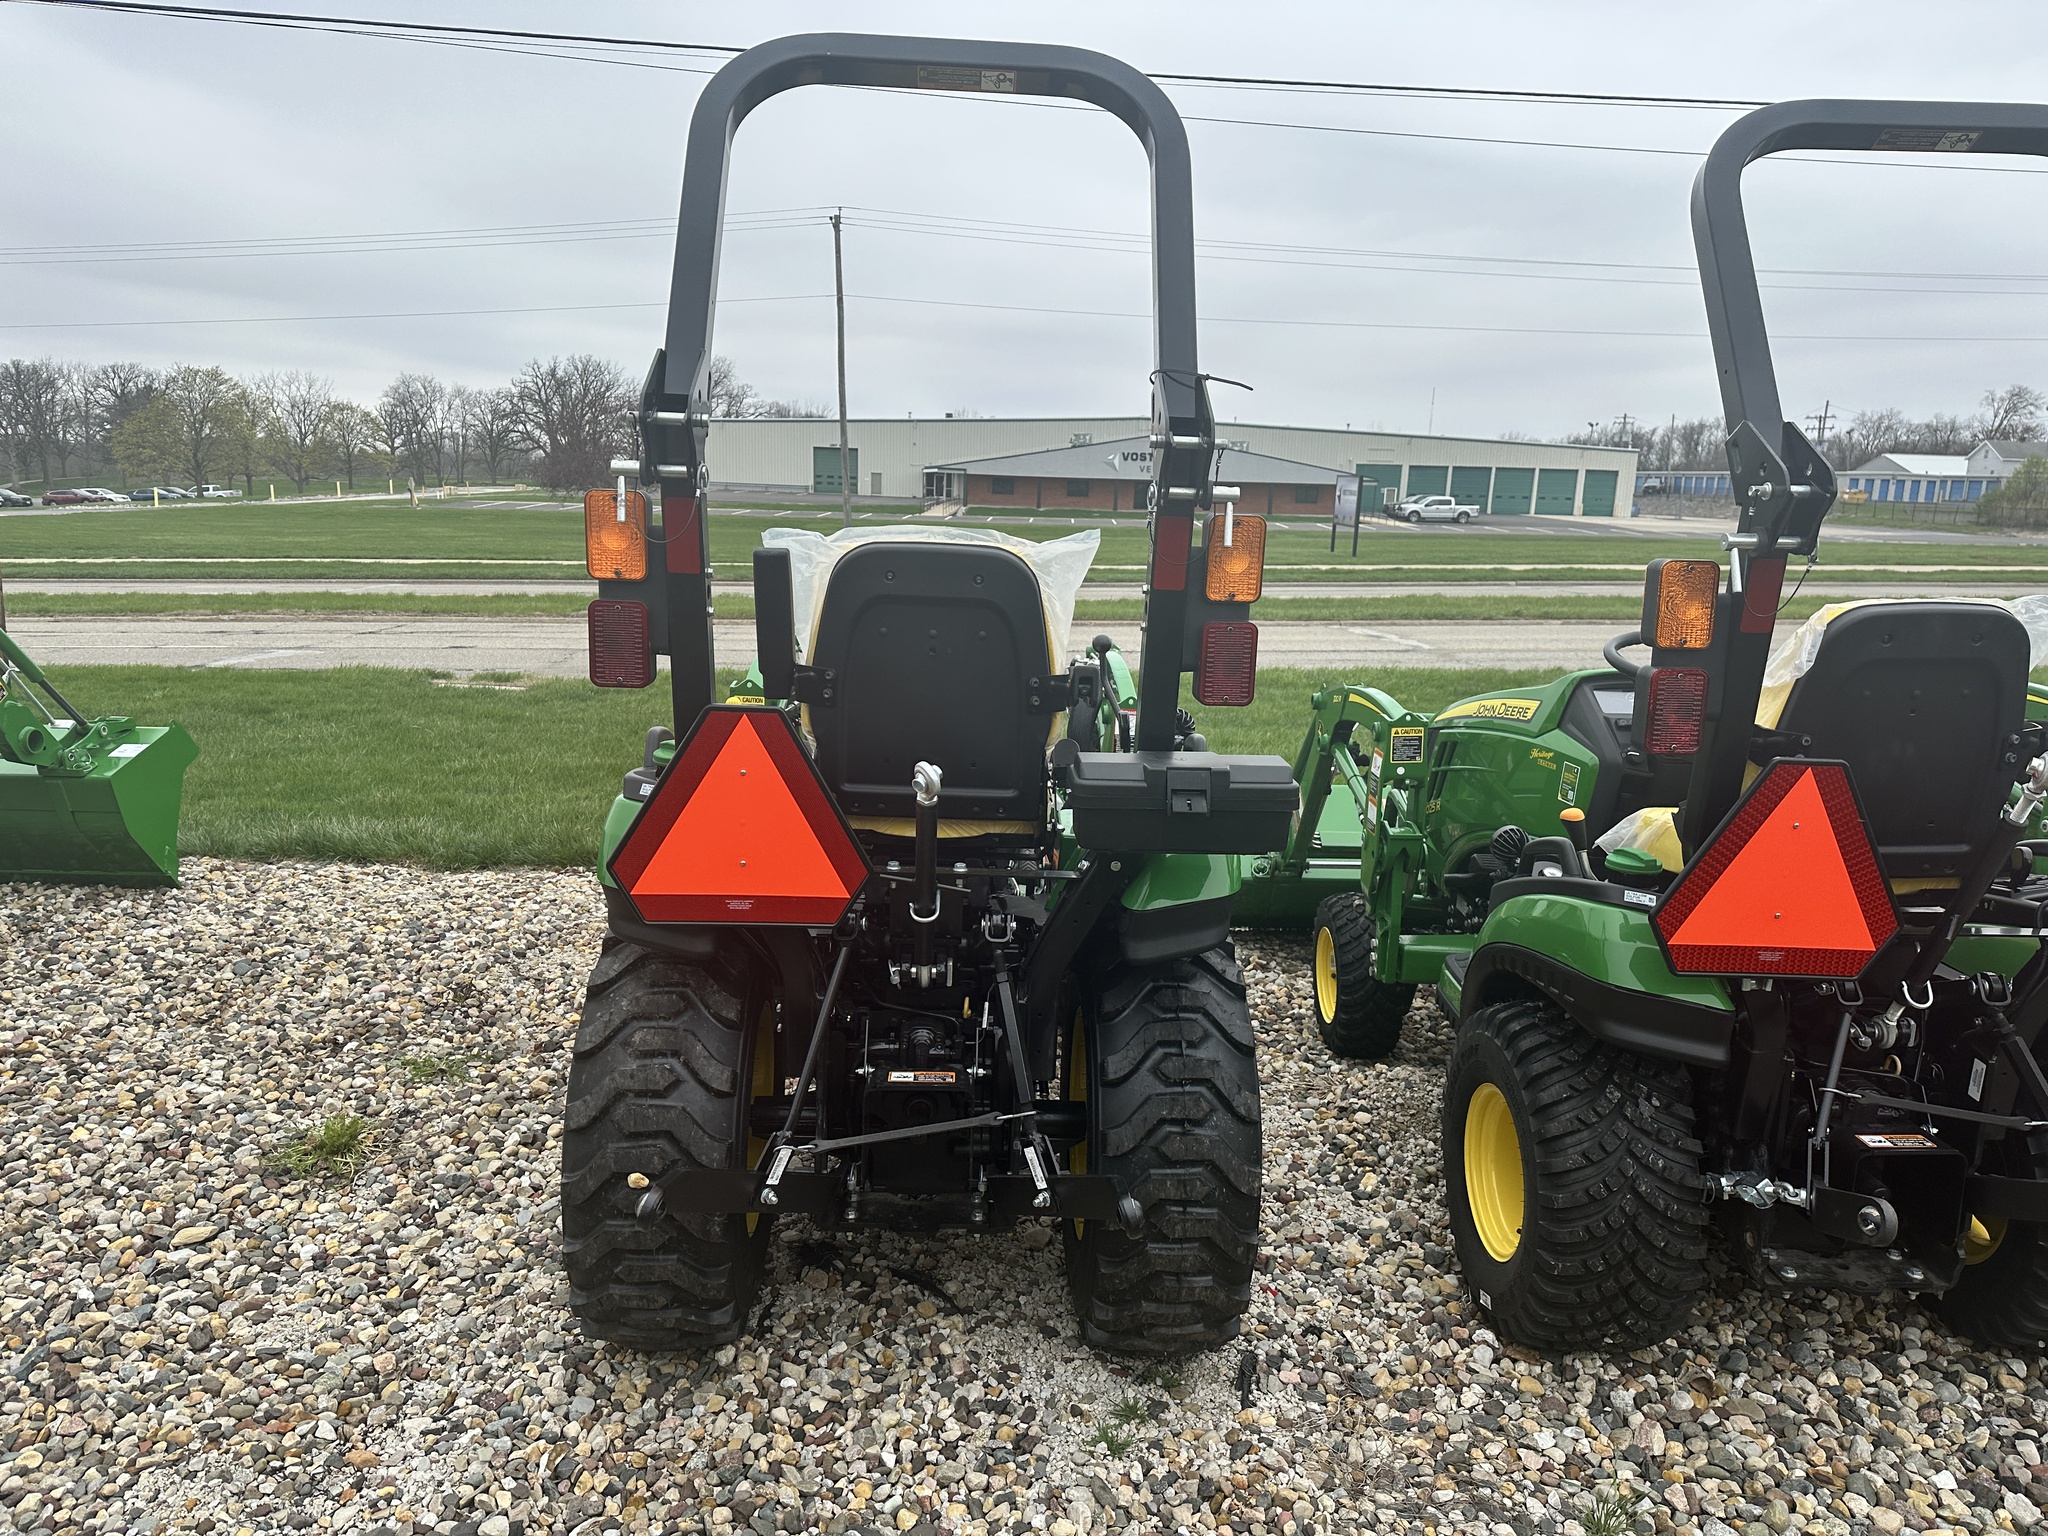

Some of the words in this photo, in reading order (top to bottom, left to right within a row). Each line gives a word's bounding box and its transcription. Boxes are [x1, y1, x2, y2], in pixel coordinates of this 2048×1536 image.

[1472, 703, 1498, 716] JOHN
[1497, 703, 1531, 719] DEERE
[1530, 748, 1555, 760] Heritage
